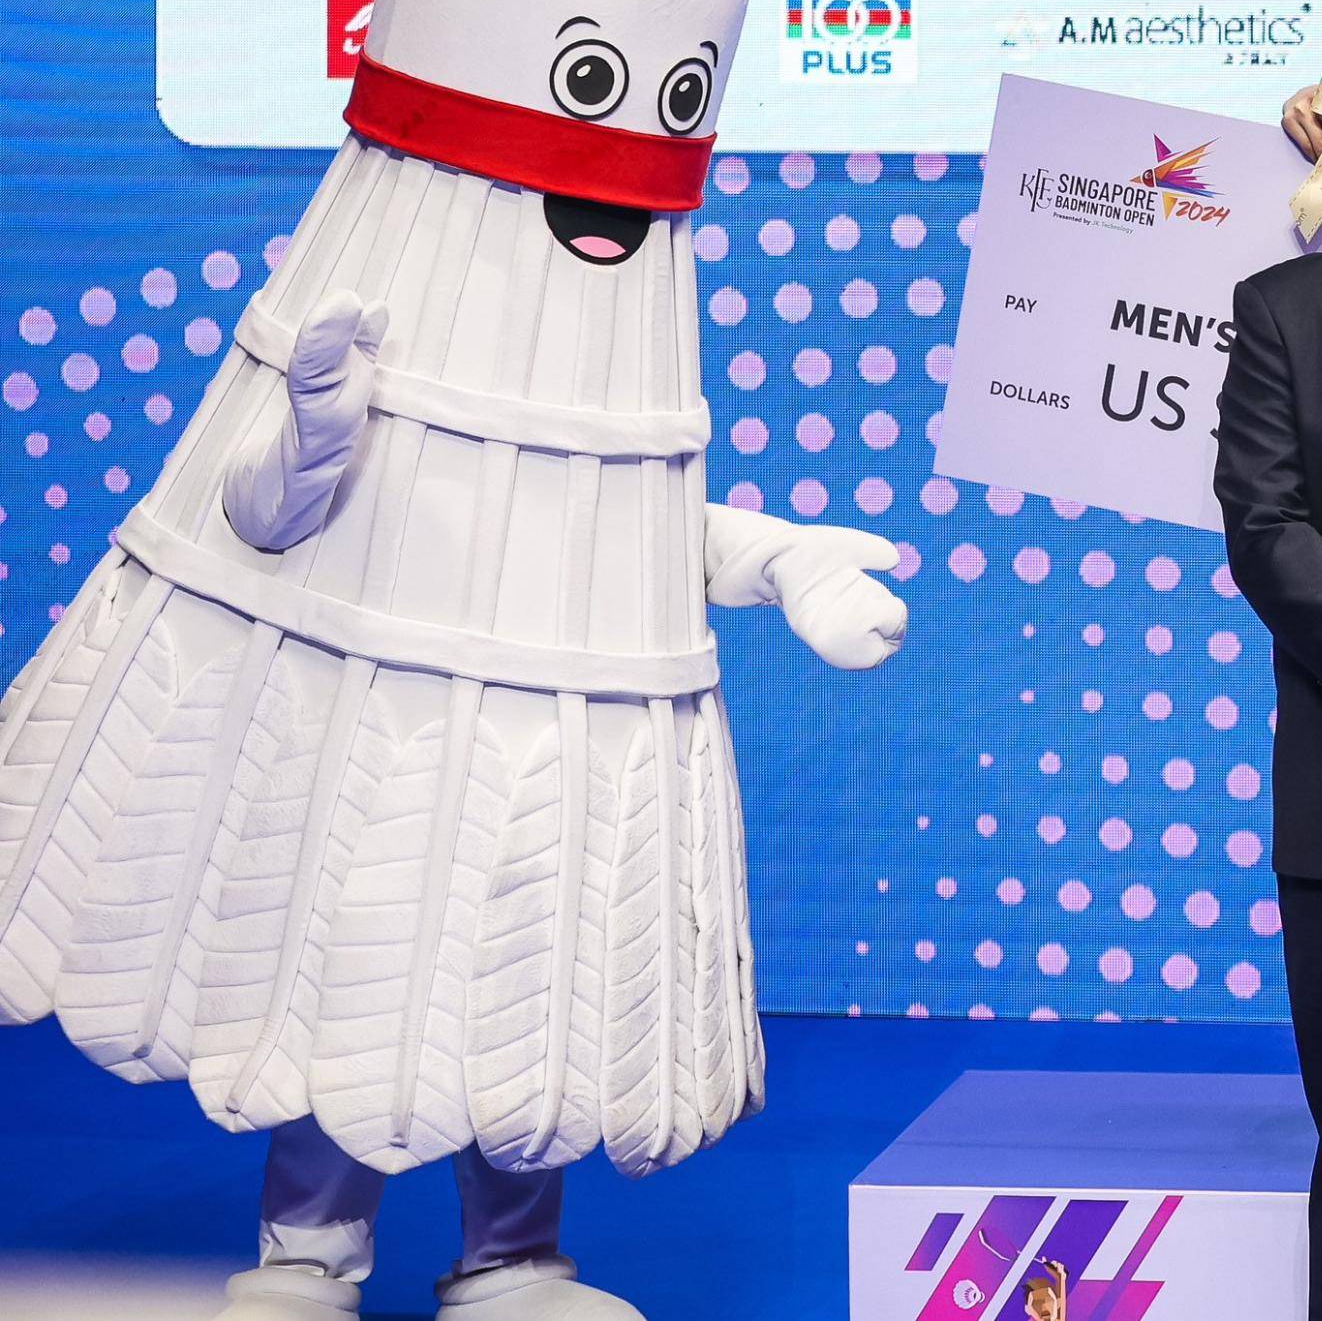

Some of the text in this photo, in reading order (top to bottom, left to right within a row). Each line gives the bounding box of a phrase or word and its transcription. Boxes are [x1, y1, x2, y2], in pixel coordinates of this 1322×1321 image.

[1058, 16, 1117, 44] A.M
[803, 50, 892, 74] PLUS
[1055, 195, 1154, 227] BADMINTON OPEN
[1058, 173, 1158, 212] SINGAPORE
[1175, 200, 1231, 227] 2024
[1053, 212, 1082, 222] Presented
[1083, 217, 1091, 225] by
[1004, 294, 1037, 313] PAY
[1110, 299, 1239, 353] MEN'S
[990, 380, 1070, 410] DOLLARS
[1101, 363, 1190, 431] US
